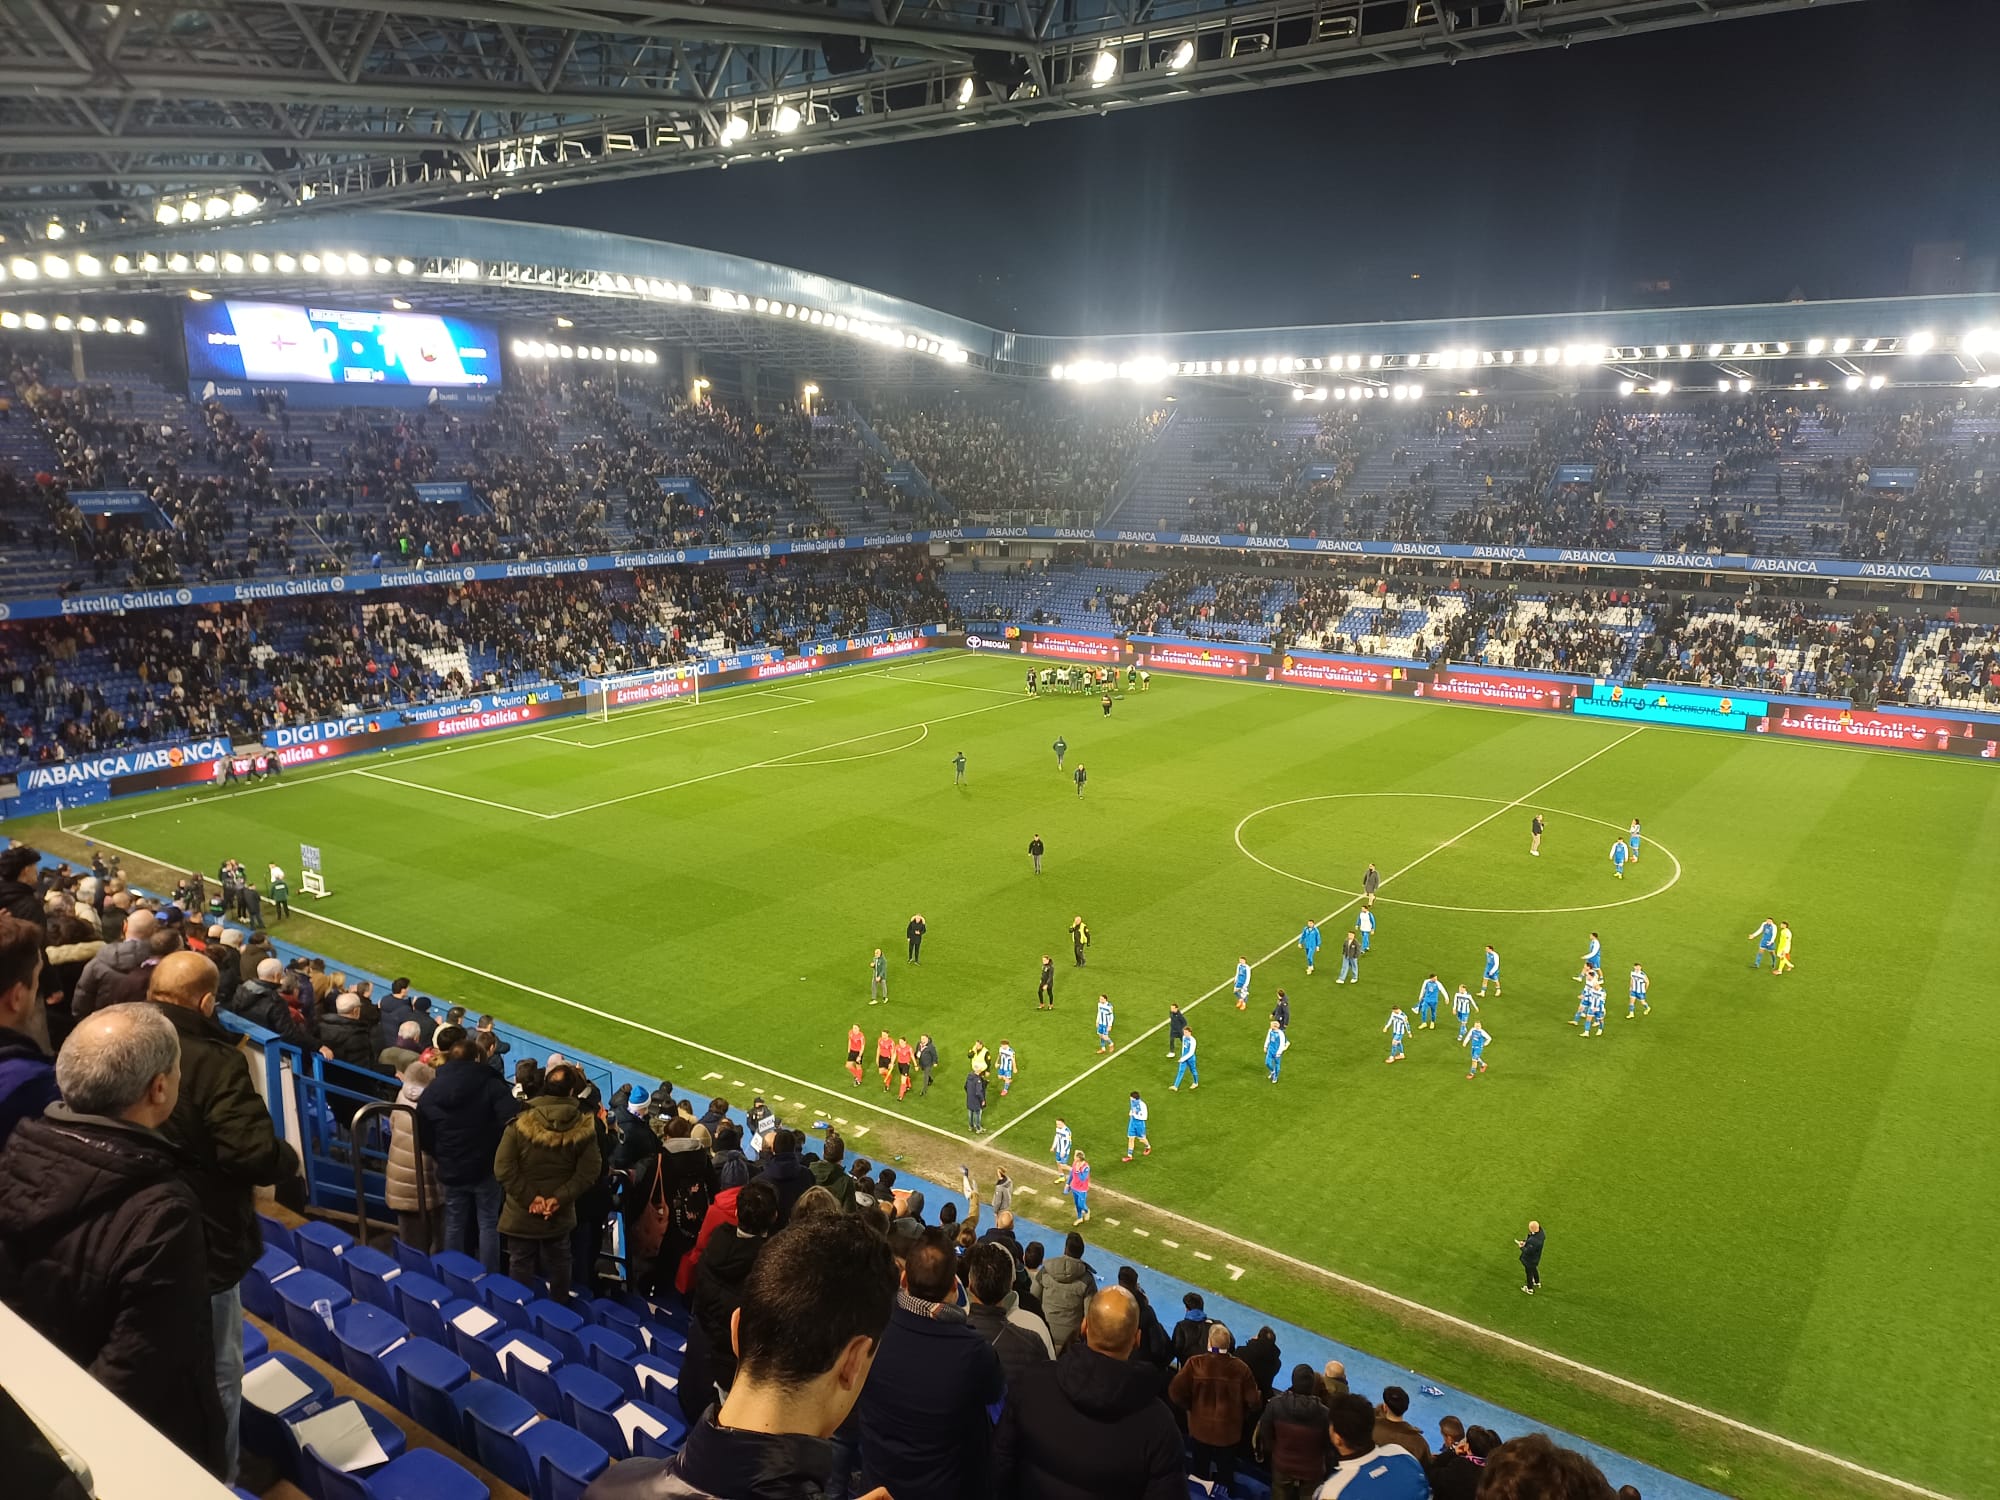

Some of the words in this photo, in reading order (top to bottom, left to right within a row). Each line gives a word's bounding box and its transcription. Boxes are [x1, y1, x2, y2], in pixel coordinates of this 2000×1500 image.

[790, 542, 815, 553] Estrella
[816, 540, 838, 550] Galicia
[863, 536, 885, 546] Estrella
[886, 534, 905, 544] Galicia
[614, 552, 646, 567] Estrella
[647, 551, 675, 565] Galicia
[708, 547, 736, 559] Estrella
[737, 545, 762, 557] Galicia
[506, 560, 543, 576] Estrella
[544, 559, 576, 573] Galicia
[380, 571, 423, 587] Estrella
[424, 569, 461, 583] Galicia
[234, 583, 284, 600] Estrella
[285, 578, 328, 595] Galicia
[60, 596, 120, 614] Estrella
[121, 591, 173, 608] Galicia
[758, 660, 785, 677] Estrella
[786, 657, 809, 673] Galicia
[617, 686, 649, 704] Estrella
[650, 681, 679, 697] Galicia
[438, 717, 480, 735] Estrella
[481, 709, 518, 727] Galicia
[277, 725, 319, 748] DIGI
